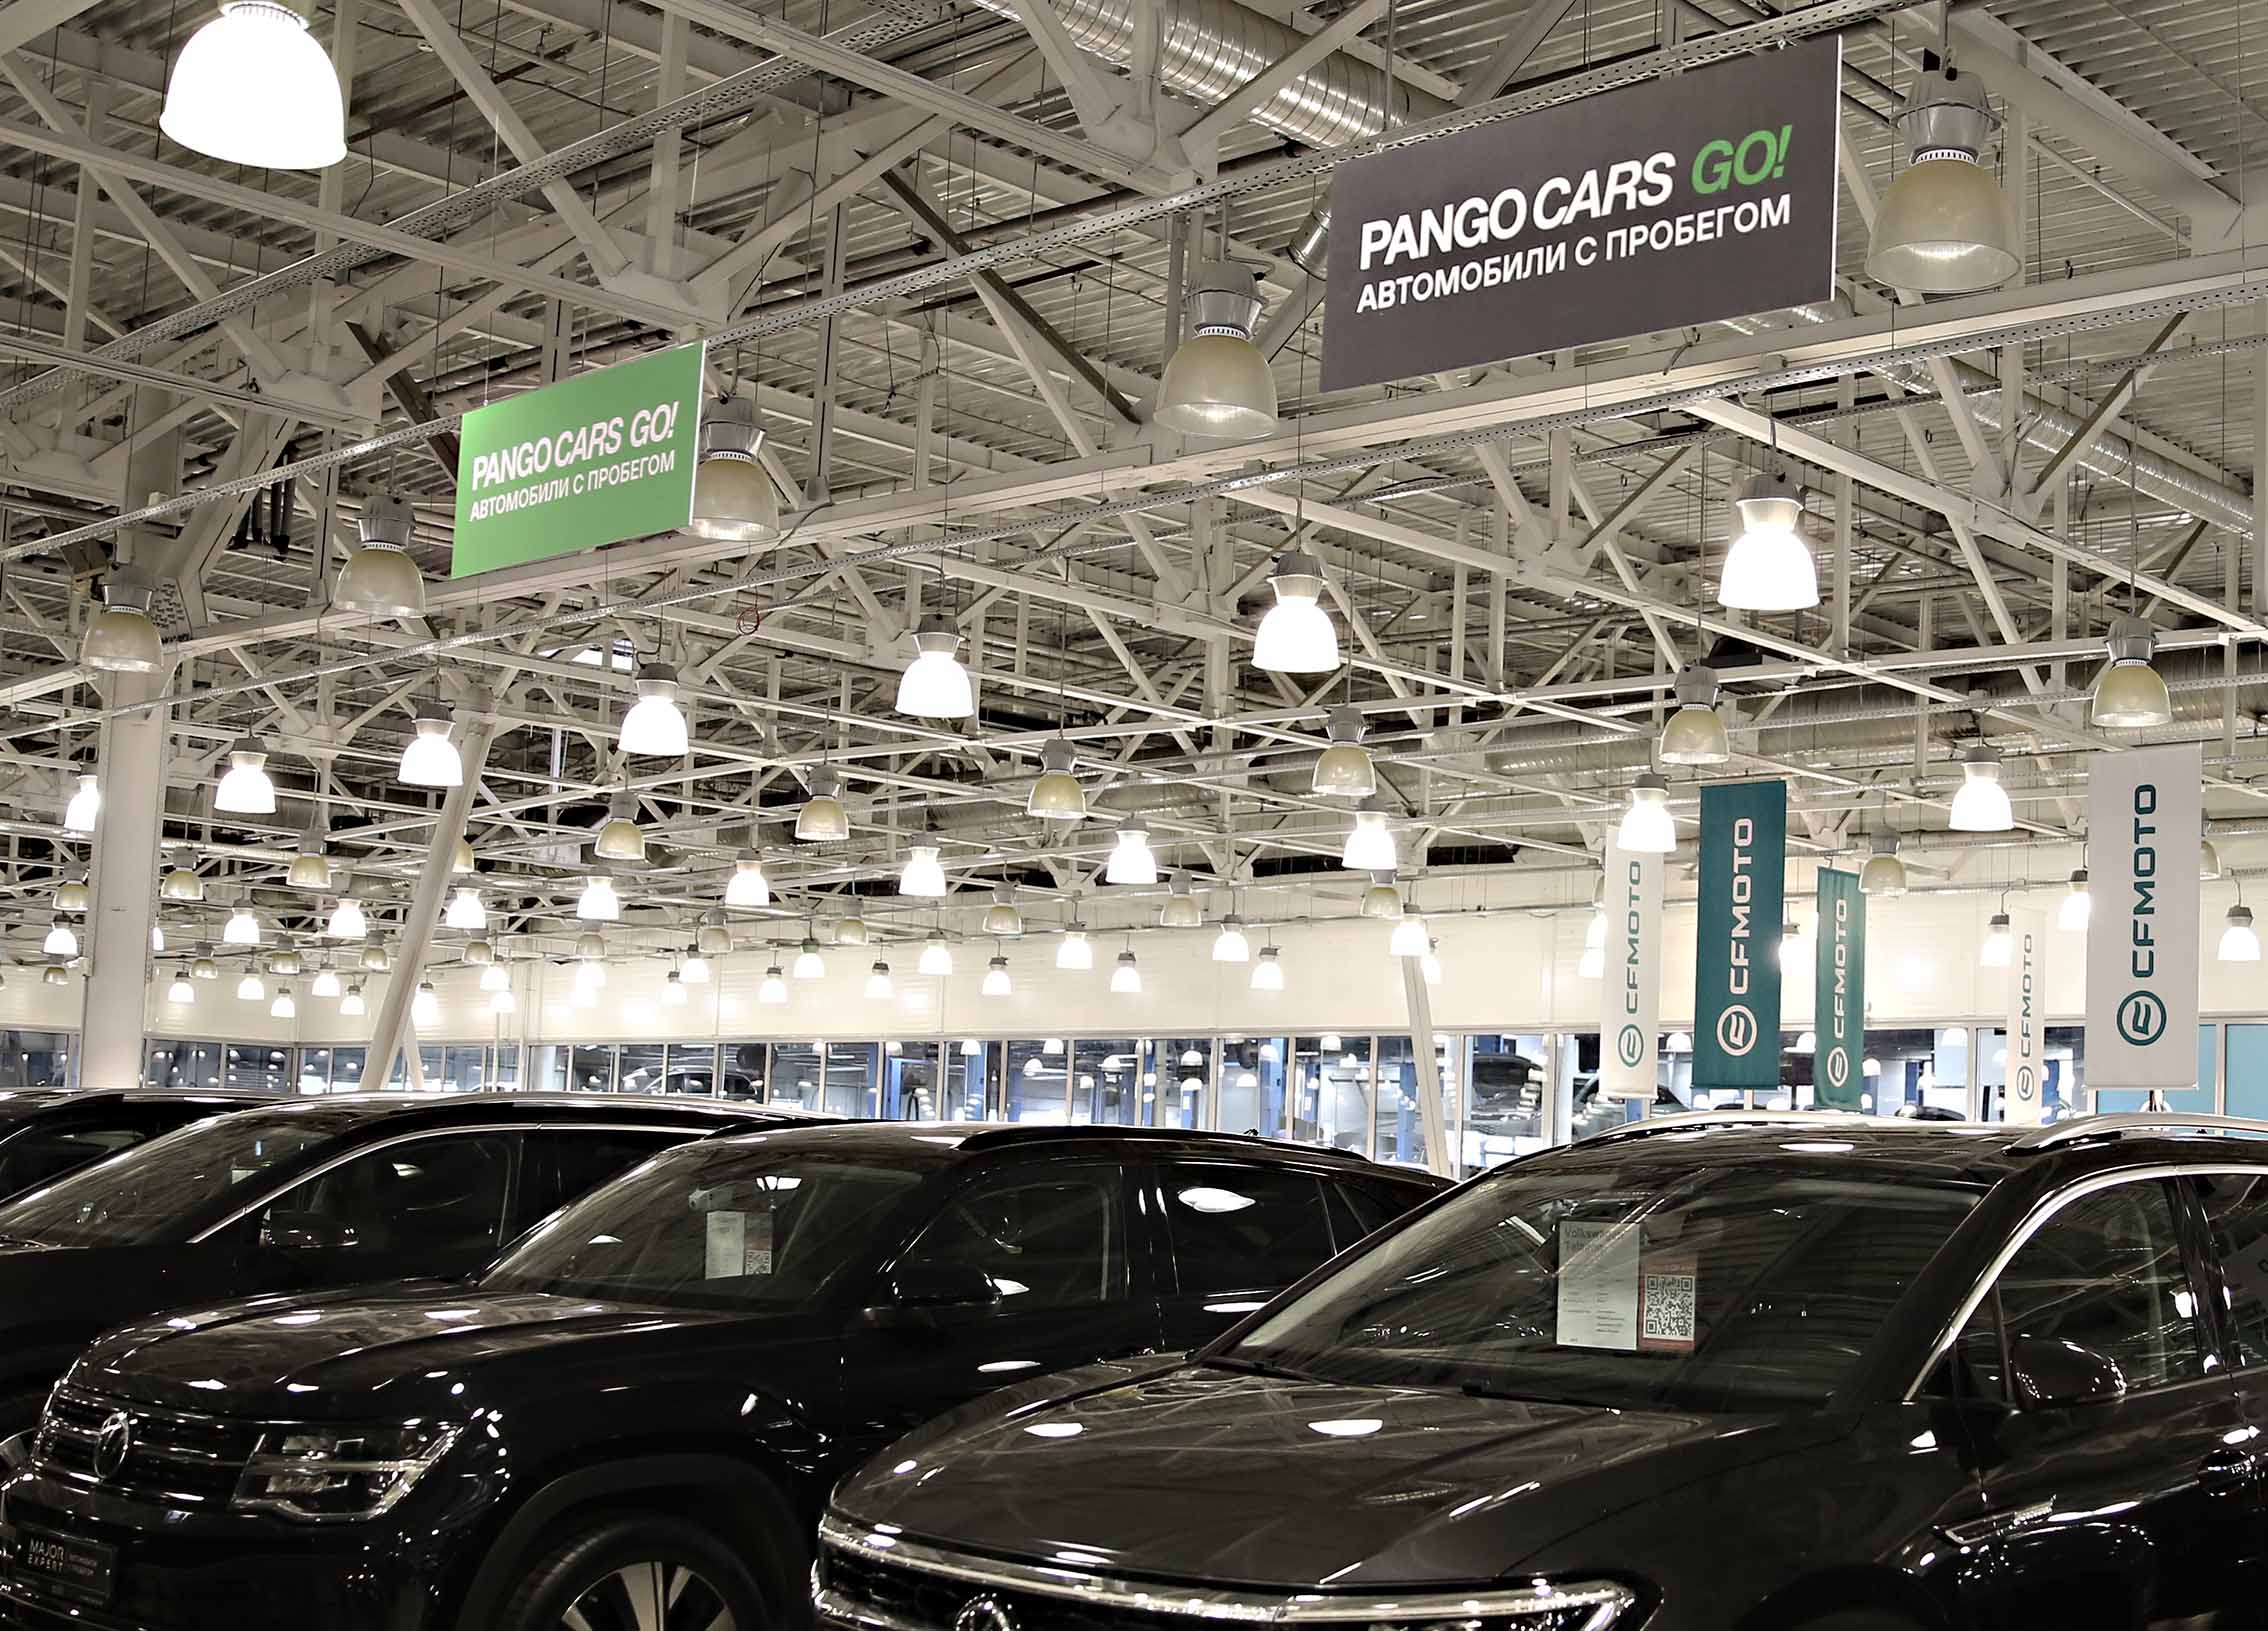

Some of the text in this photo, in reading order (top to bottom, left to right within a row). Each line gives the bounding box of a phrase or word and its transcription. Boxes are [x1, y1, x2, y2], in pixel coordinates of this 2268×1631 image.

[1691, 124, 1793, 195] GO!
[1356, 194, 1791, 313] АВТОМОБИЛИ С ПРОБЕГОМ
[630, 402, 679, 446] GO!
[469, 450, 675, 522] АВТОМОБИЛИ С ПРОБЕГОМ
[1626, 861, 1641, 1014] CFMOTO
[1729, 817, 1753, 995] CFMOTO
[2132, 784, 2156, 978] CFMOTO
[1834, 899, 1848, 1038] CFMOTO
[2021, 934, 2032, 1057] CFMOTO
[28, 1554, 63, 1572] EXPERT
[29, 1538, 64, 1560] MAJOR
